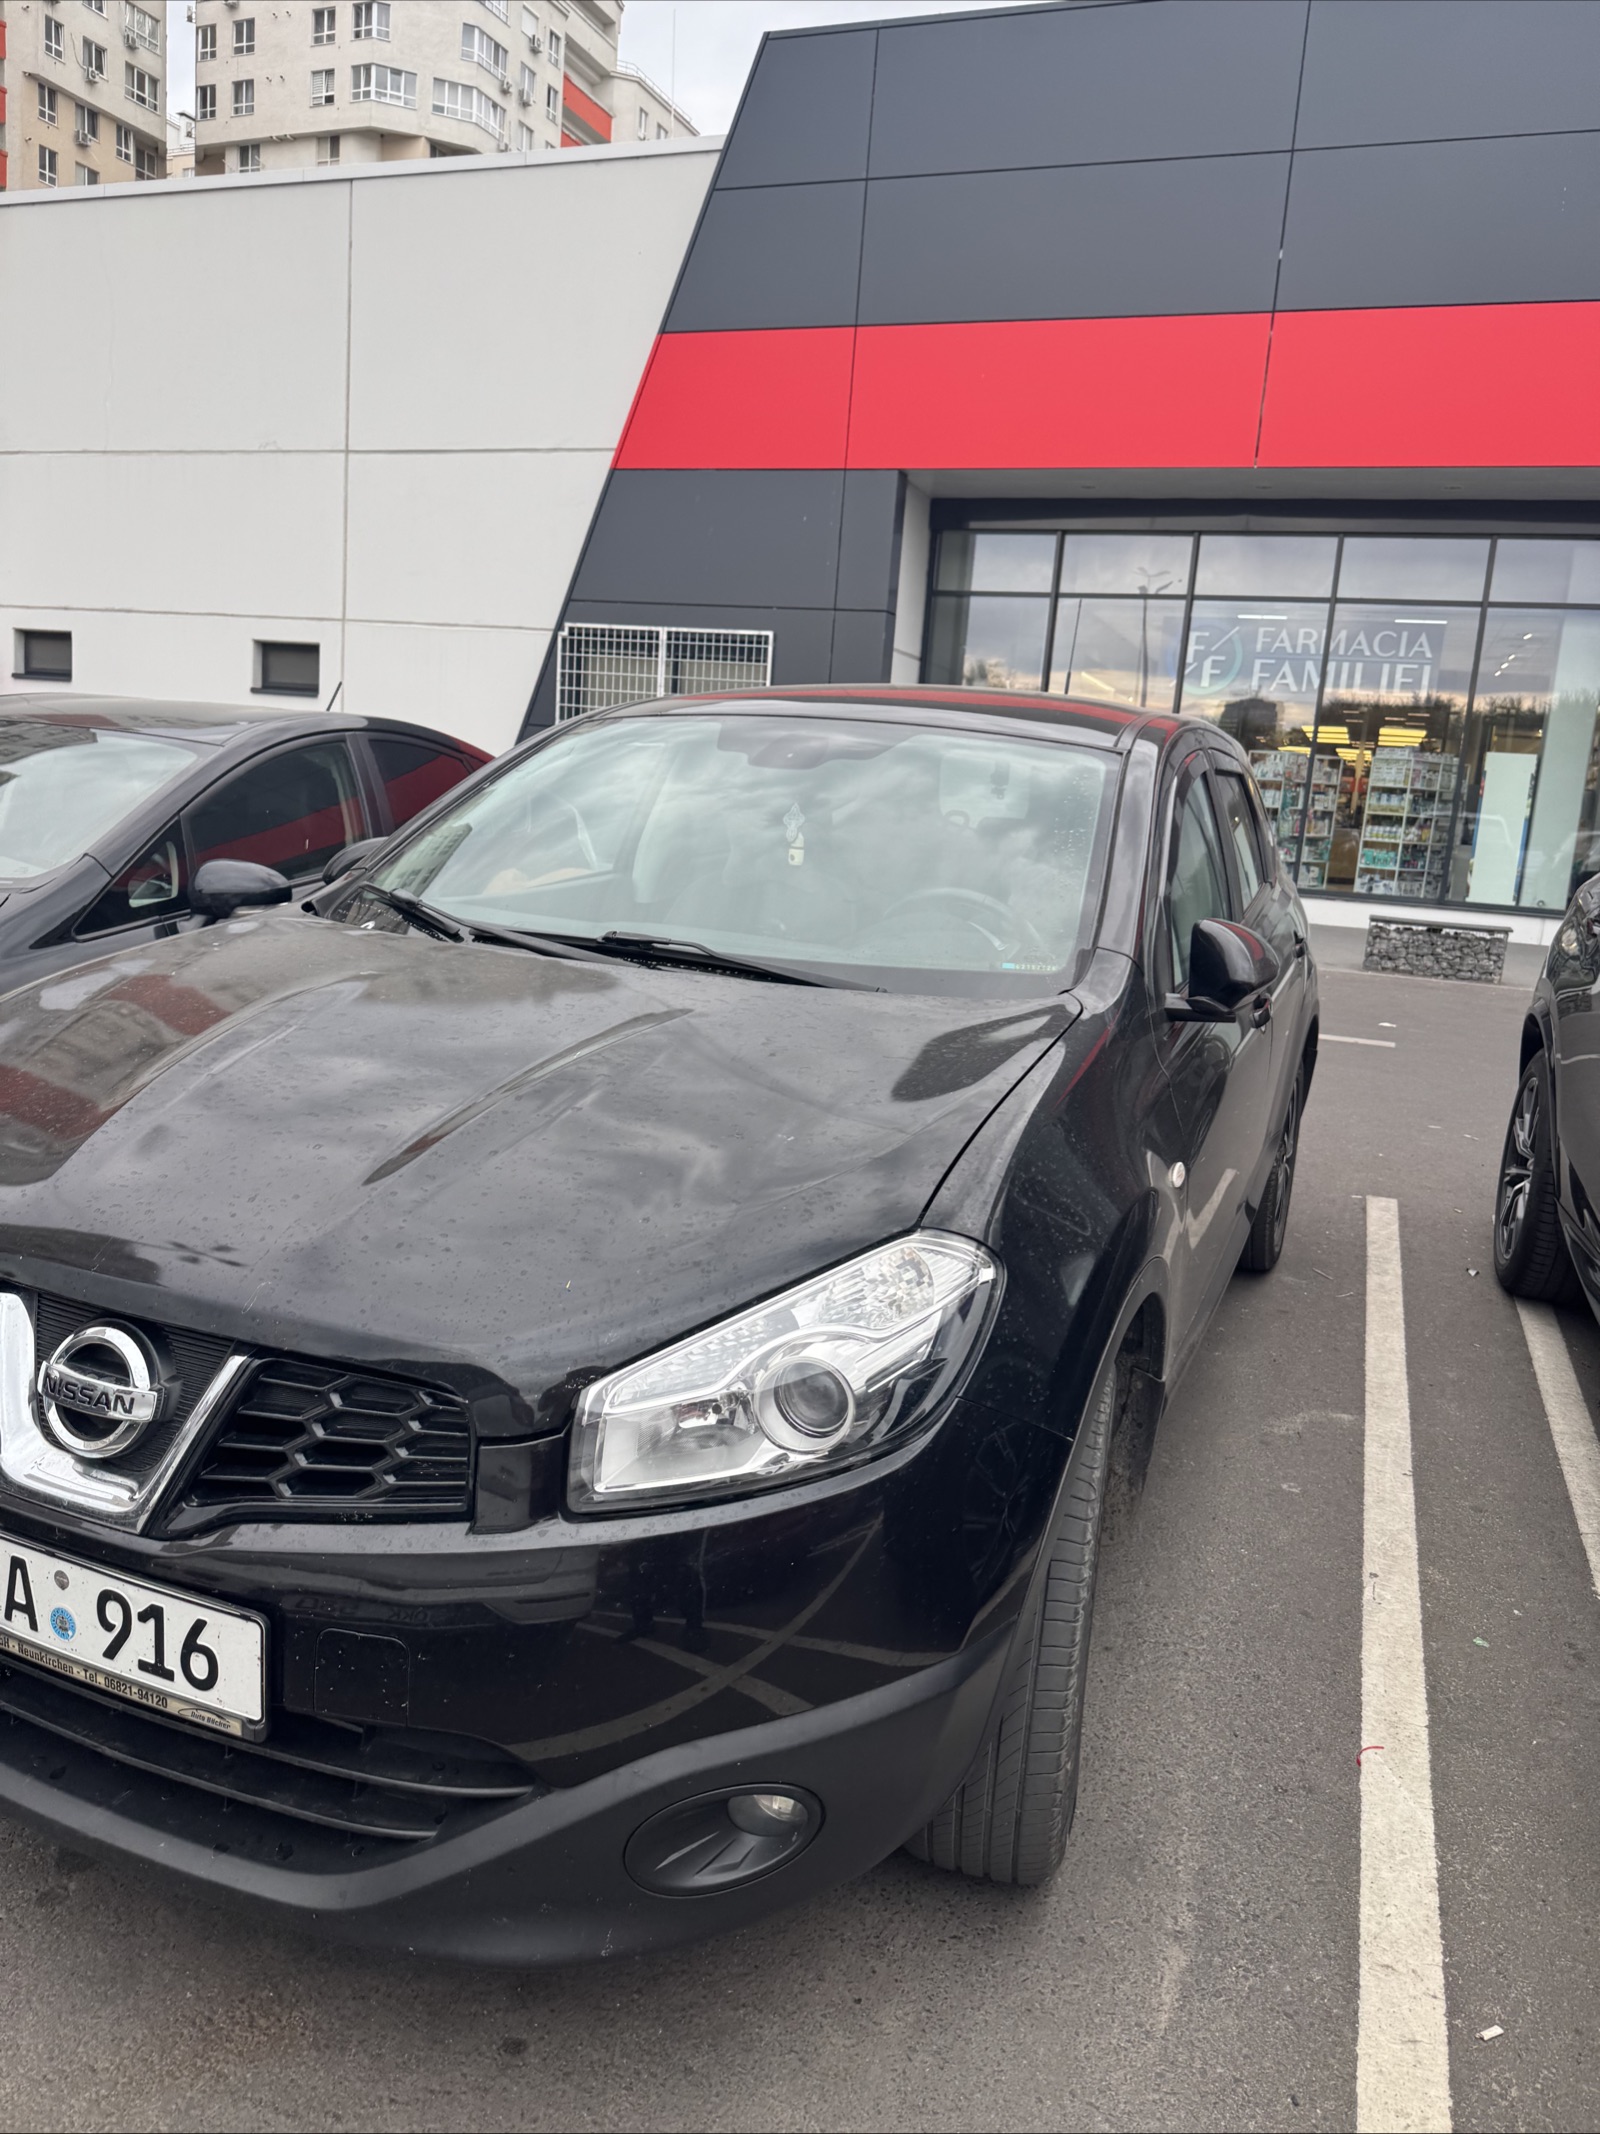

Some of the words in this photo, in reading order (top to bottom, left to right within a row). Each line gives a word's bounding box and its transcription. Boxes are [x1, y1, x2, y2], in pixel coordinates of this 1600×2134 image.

[1255, 627, 1433, 659] FARMACIA
[1250, 658, 1433, 697] FAMILIEI
[43, 1374, 135, 1415] NISSAN
[4, 1554, 39, 1633] A
[96, 1586, 219, 1692] 916
[17, 1642, 74, 1675] Neunkirchen
[82, 1668, 101, 1685] Tel.
[104, 1676, 168, 1709] 06821-94120
